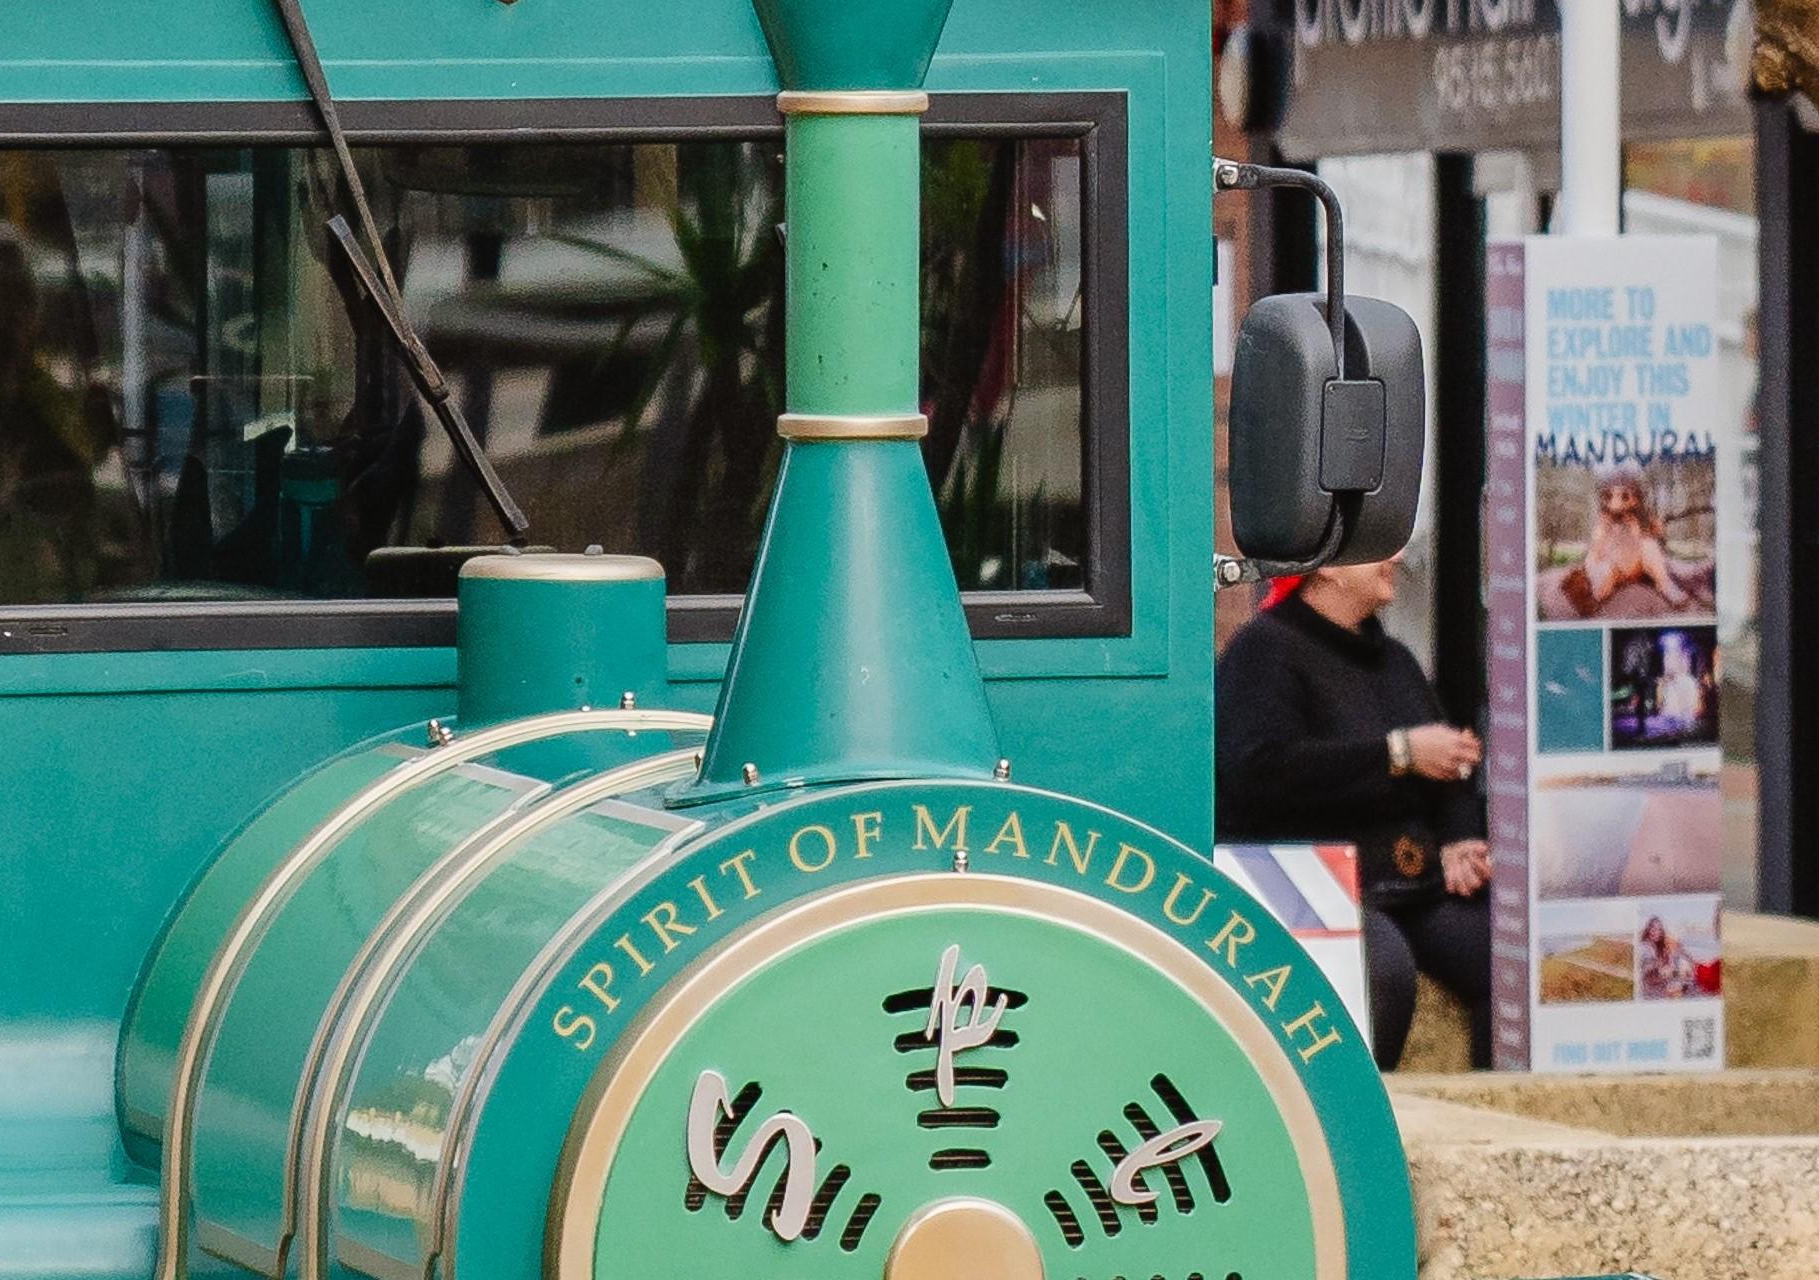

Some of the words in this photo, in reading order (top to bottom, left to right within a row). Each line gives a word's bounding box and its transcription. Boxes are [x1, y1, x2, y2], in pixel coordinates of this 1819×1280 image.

[1547, 288, 1614, 320] MORE
[1627, 286, 1654, 319] TO
[1547, 325, 1653, 358] EXPLORE
[1664, 324, 1711, 357] AND
[1548, 364, 1623, 396] ENJOY
[1636, 363, 1689, 395] THIS
[1548, 403, 1636, 434] WINTER
[553, 849, 766, 1051] SPIRIT
[789, 811, 886, 874] OF
[912, 804, 1343, 1065] MANDURAH
